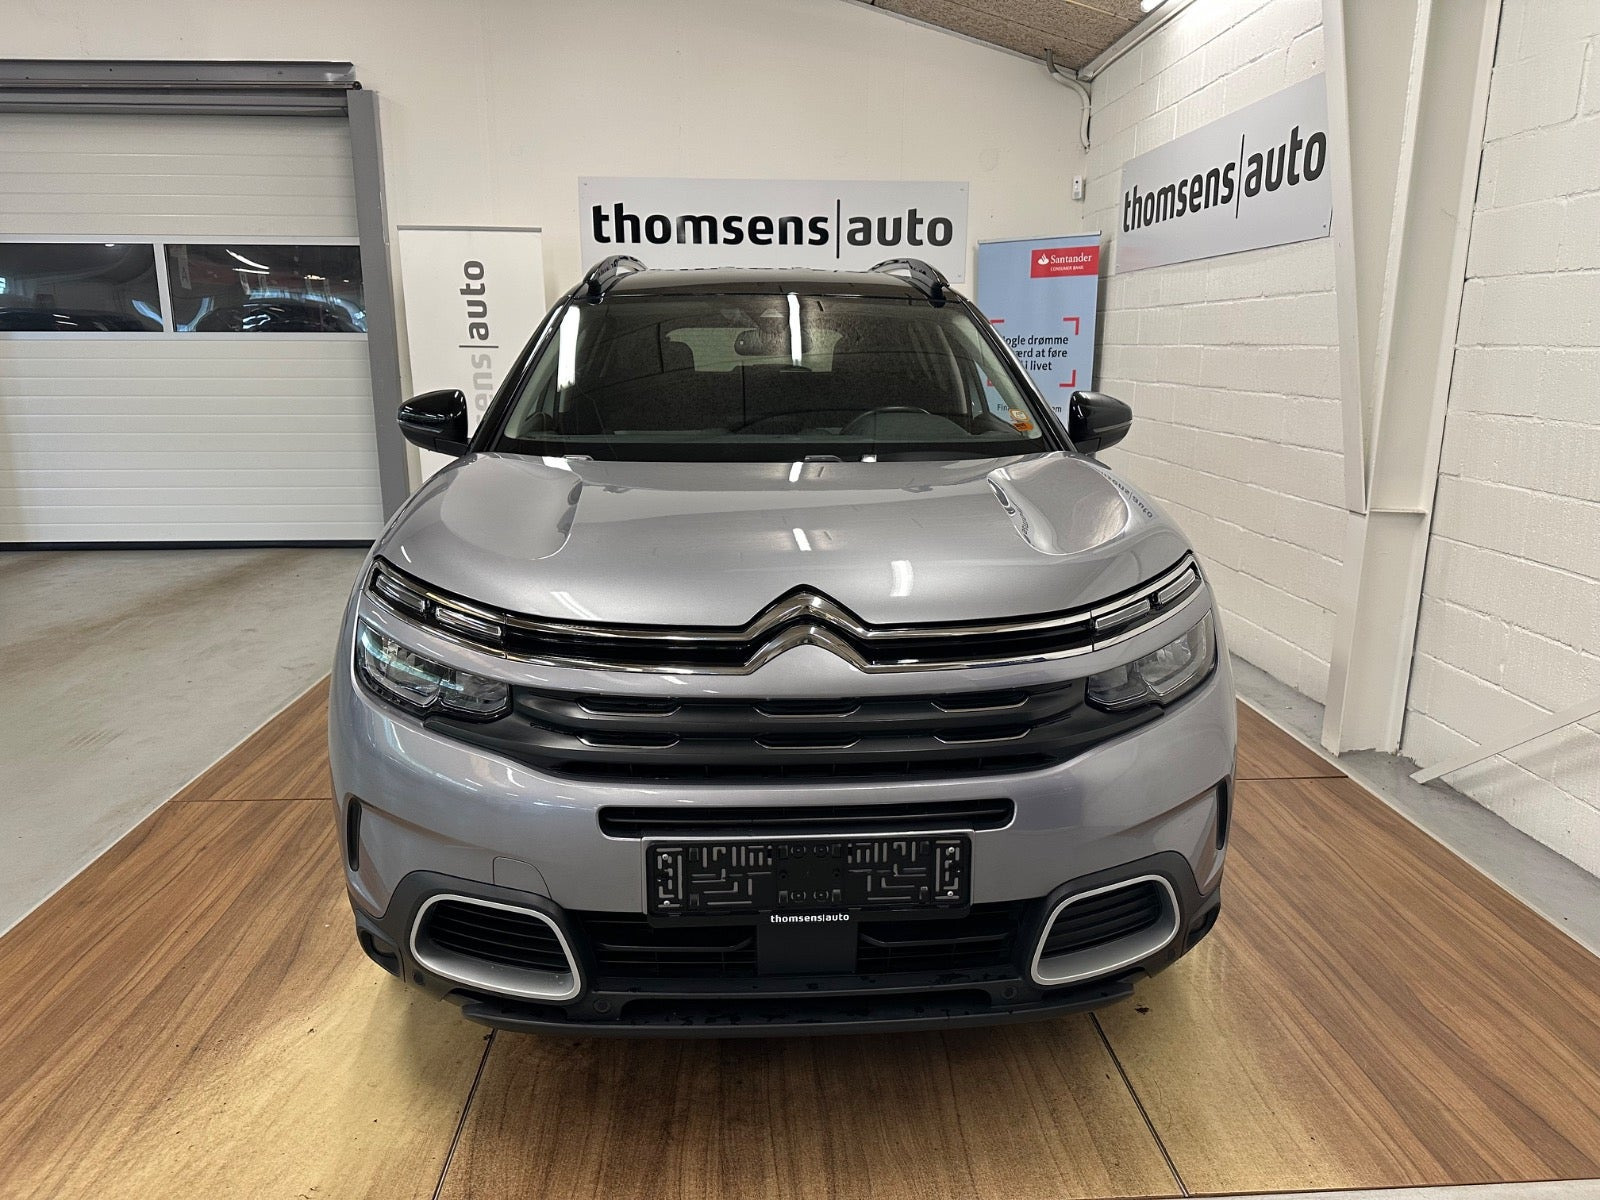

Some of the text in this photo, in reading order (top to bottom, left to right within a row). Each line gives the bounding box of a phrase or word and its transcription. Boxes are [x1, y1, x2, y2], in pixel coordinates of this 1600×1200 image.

[1050, 252, 1092, 264] Santander
[1028, 335, 1069, 345] drømme
[1035, 349, 1045, 358] at
[1048, 348, 1068, 358] føre
[1030, 361, 1053, 371] livet
